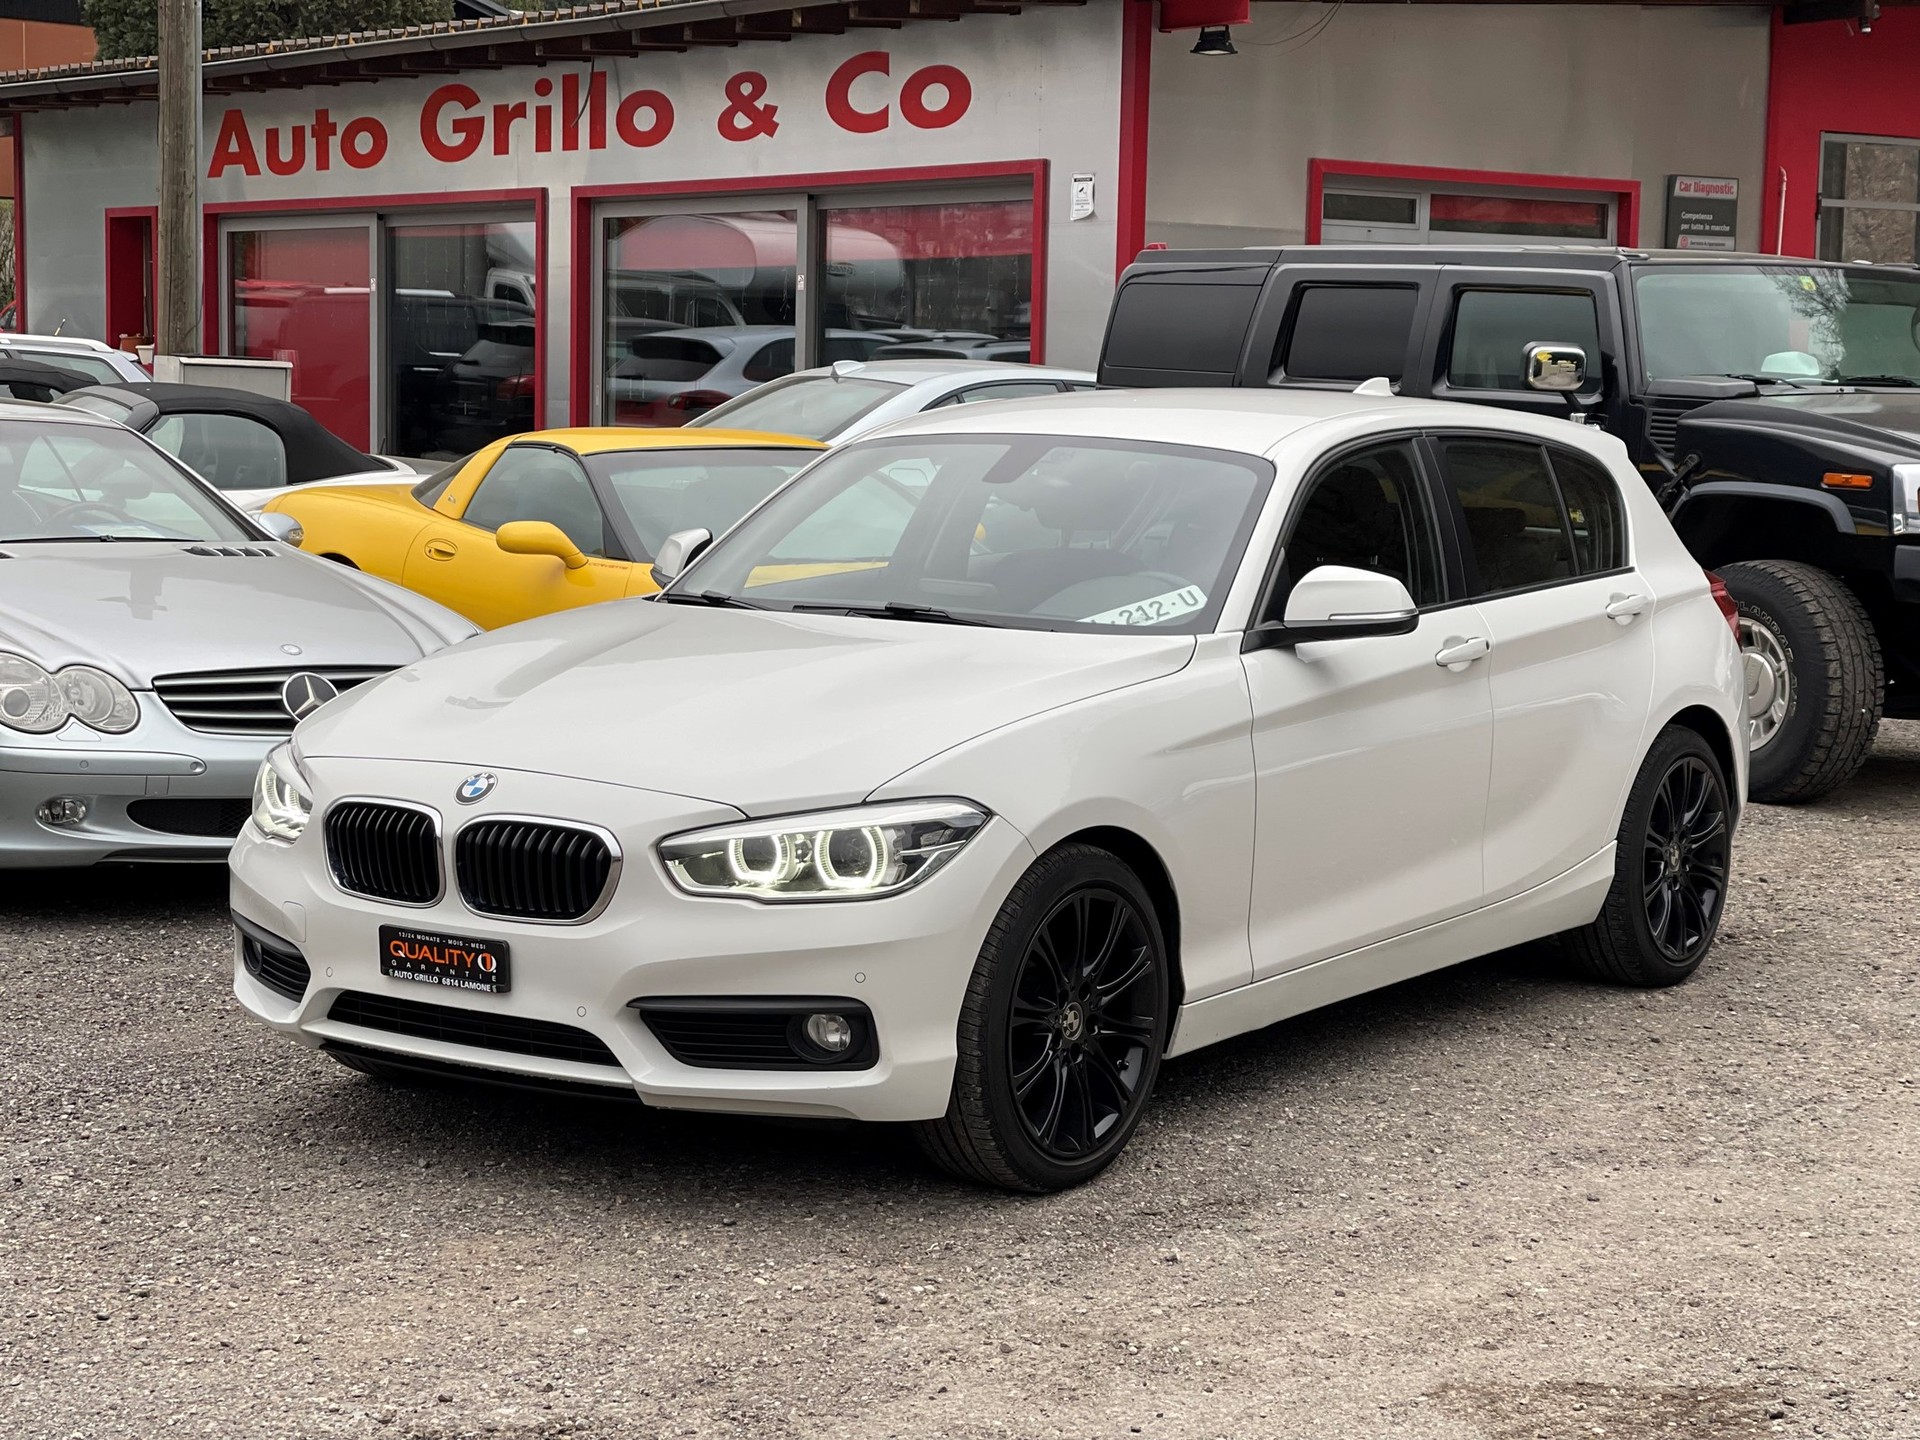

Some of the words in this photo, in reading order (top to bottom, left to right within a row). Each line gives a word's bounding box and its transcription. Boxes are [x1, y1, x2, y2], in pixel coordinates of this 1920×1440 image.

[207, 108, 388, 178] Auto
[420, 71, 675, 163] Grillo
[716, 71, 780, 141] &
[825, 51, 972, 133] Co
[1679, 181, 1692, 192] Car
[1693, 181, 1735, 196] Diagnostic
[1681, 211, 1713, 220] Competenza
[1680, 223, 1690, 231] per
[1711, 223, 1730, 231] marche
[1734, 600, 1794, 663] LANDAR
[416, 934, 441, 943] MONATE
[448, 938, 463, 947] MOIS
[470, 942, 486, 950] MESI
[389, 940, 475, 968] QUALITY
[393, 969, 413, 980] AUTO
[414, 971, 439, 984] GRILLO
[441, 976, 459, 987] 6814
[459, 980, 491, 992] LAMONE
